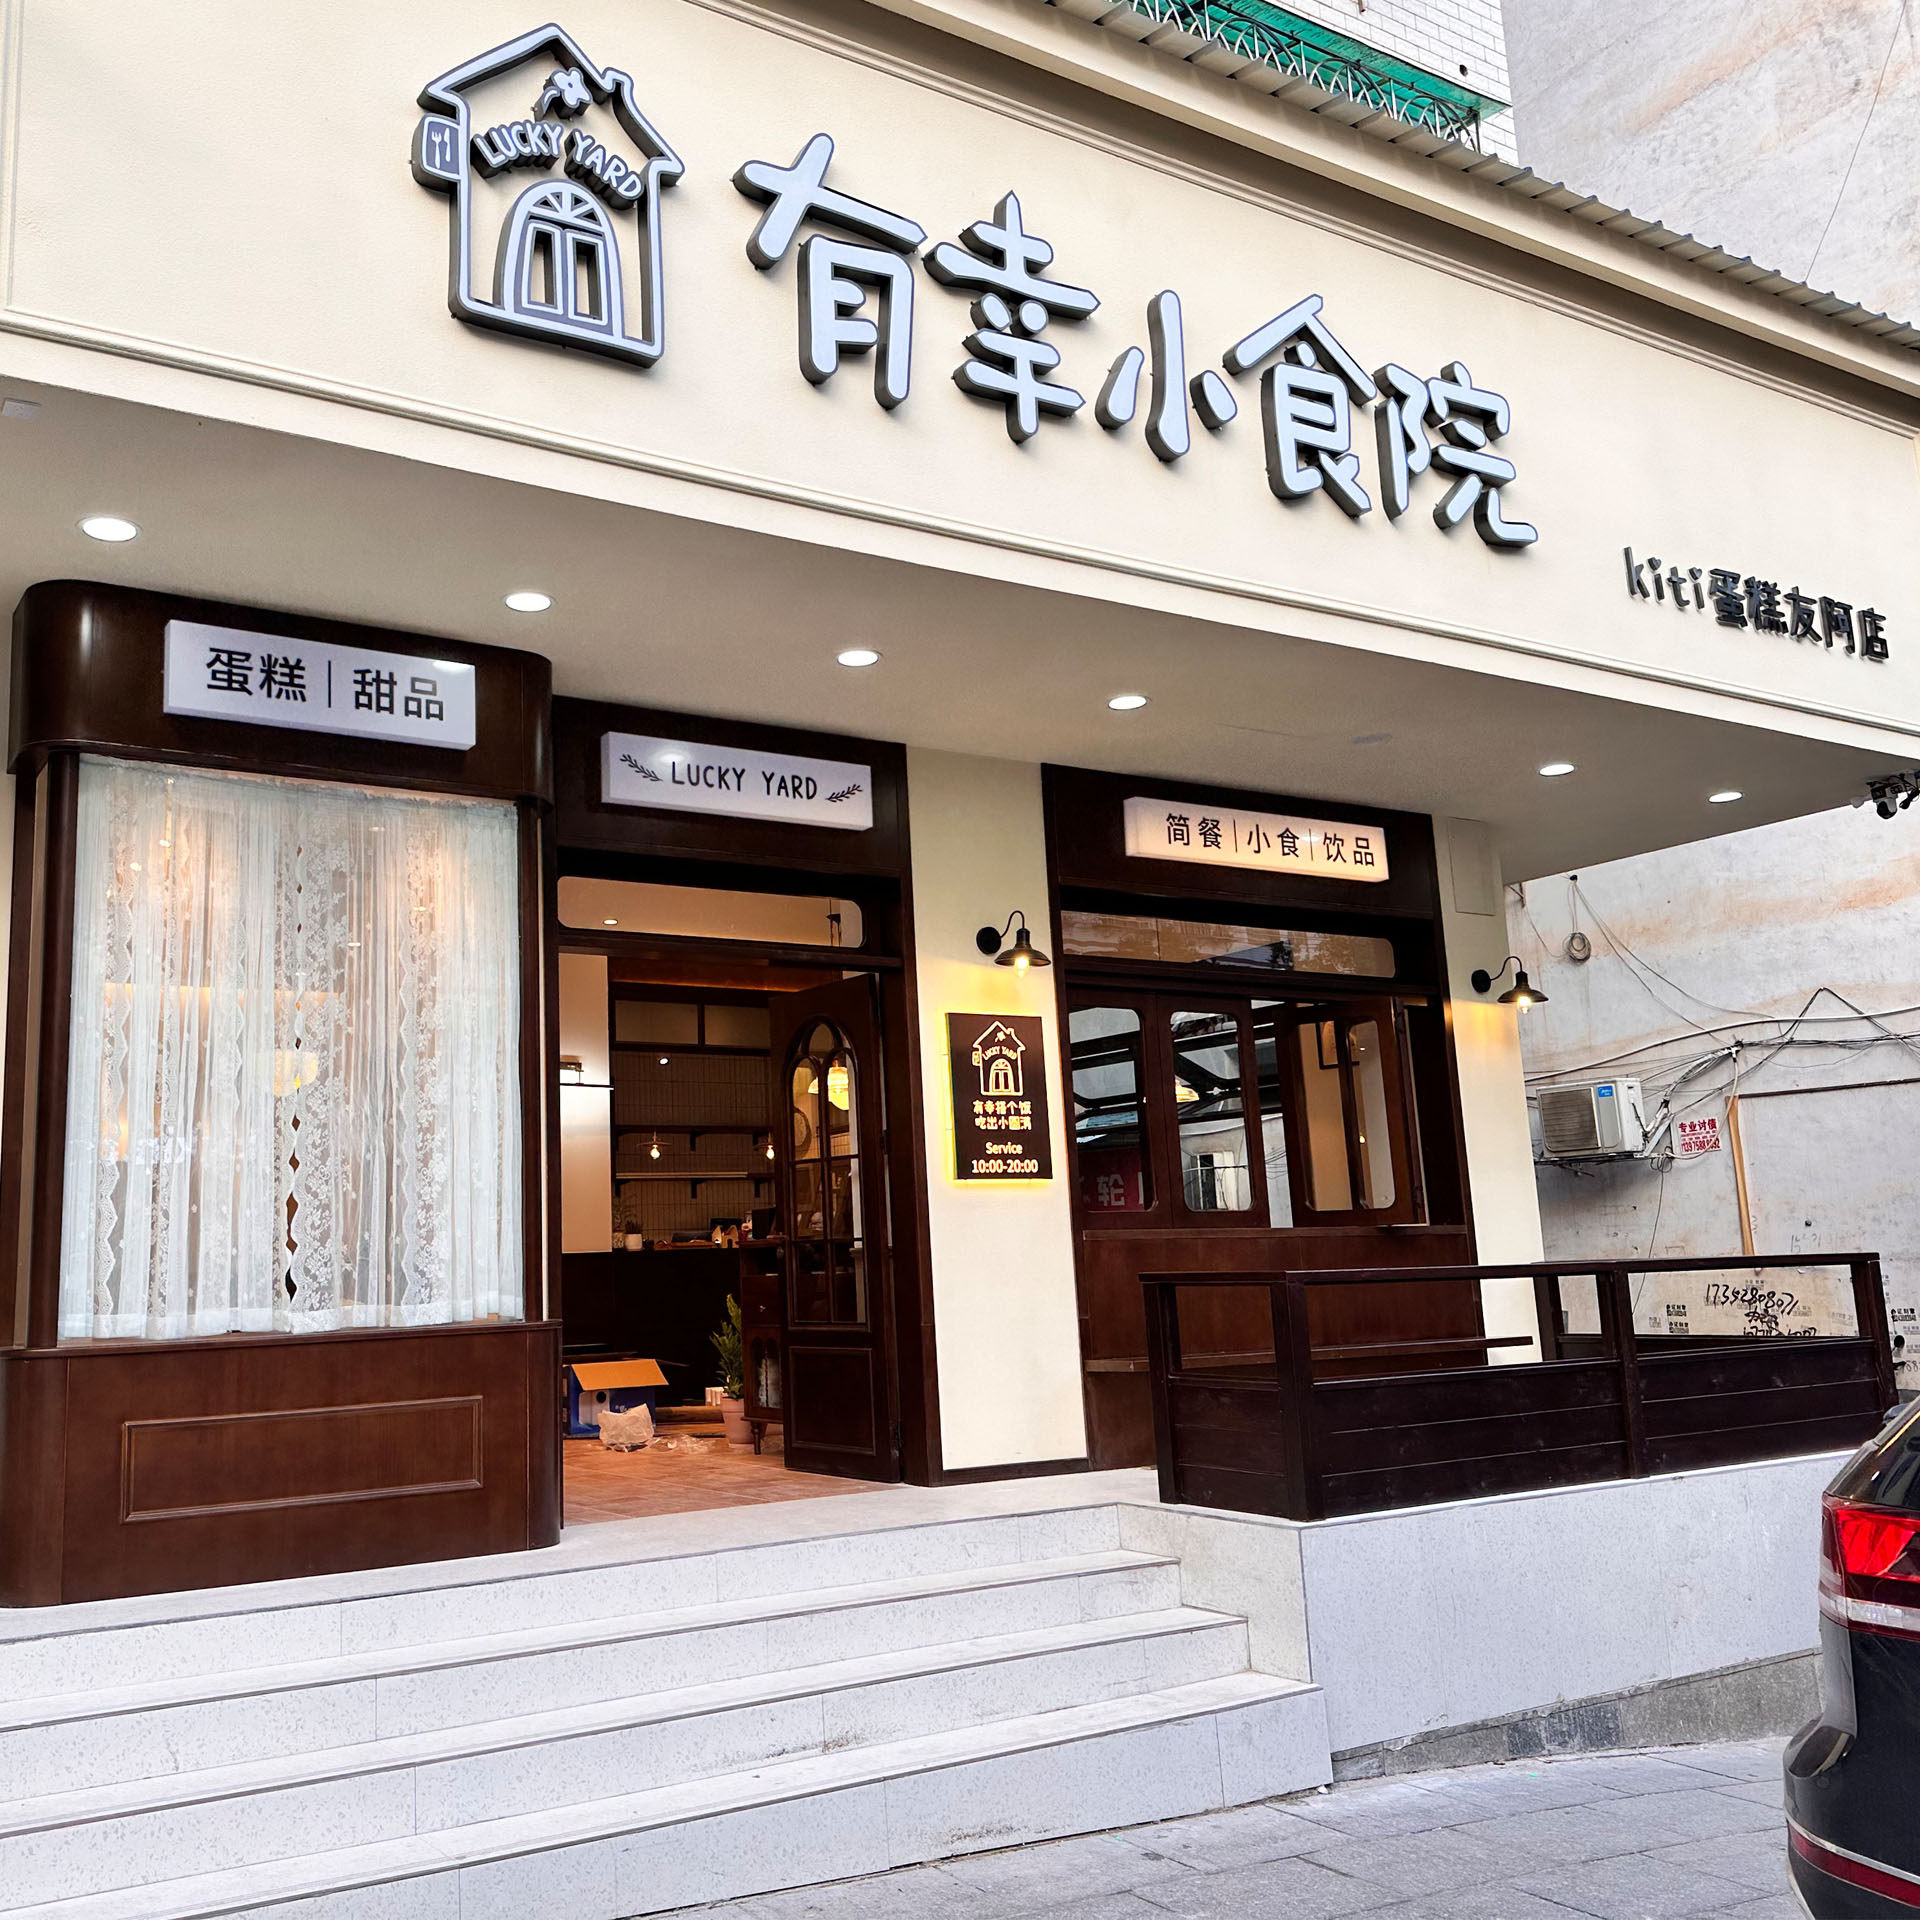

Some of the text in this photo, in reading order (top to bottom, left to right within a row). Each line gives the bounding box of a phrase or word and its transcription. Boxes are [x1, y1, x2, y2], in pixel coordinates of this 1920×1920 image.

[474, 119, 645, 202] LUCKY YARD
[732, 132, 1539, 547] 有幸小食院
[206, 647, 444, 721] 蛋糕 甜品
[671, 761, 817, 800] LUCKY YARD
[1165, 813, 1375, 867] 简餐 小食 饮品
[971, 1159, 1039, 1174] 10:00-20:00
[985, 1141, 1023, 1154] Service
